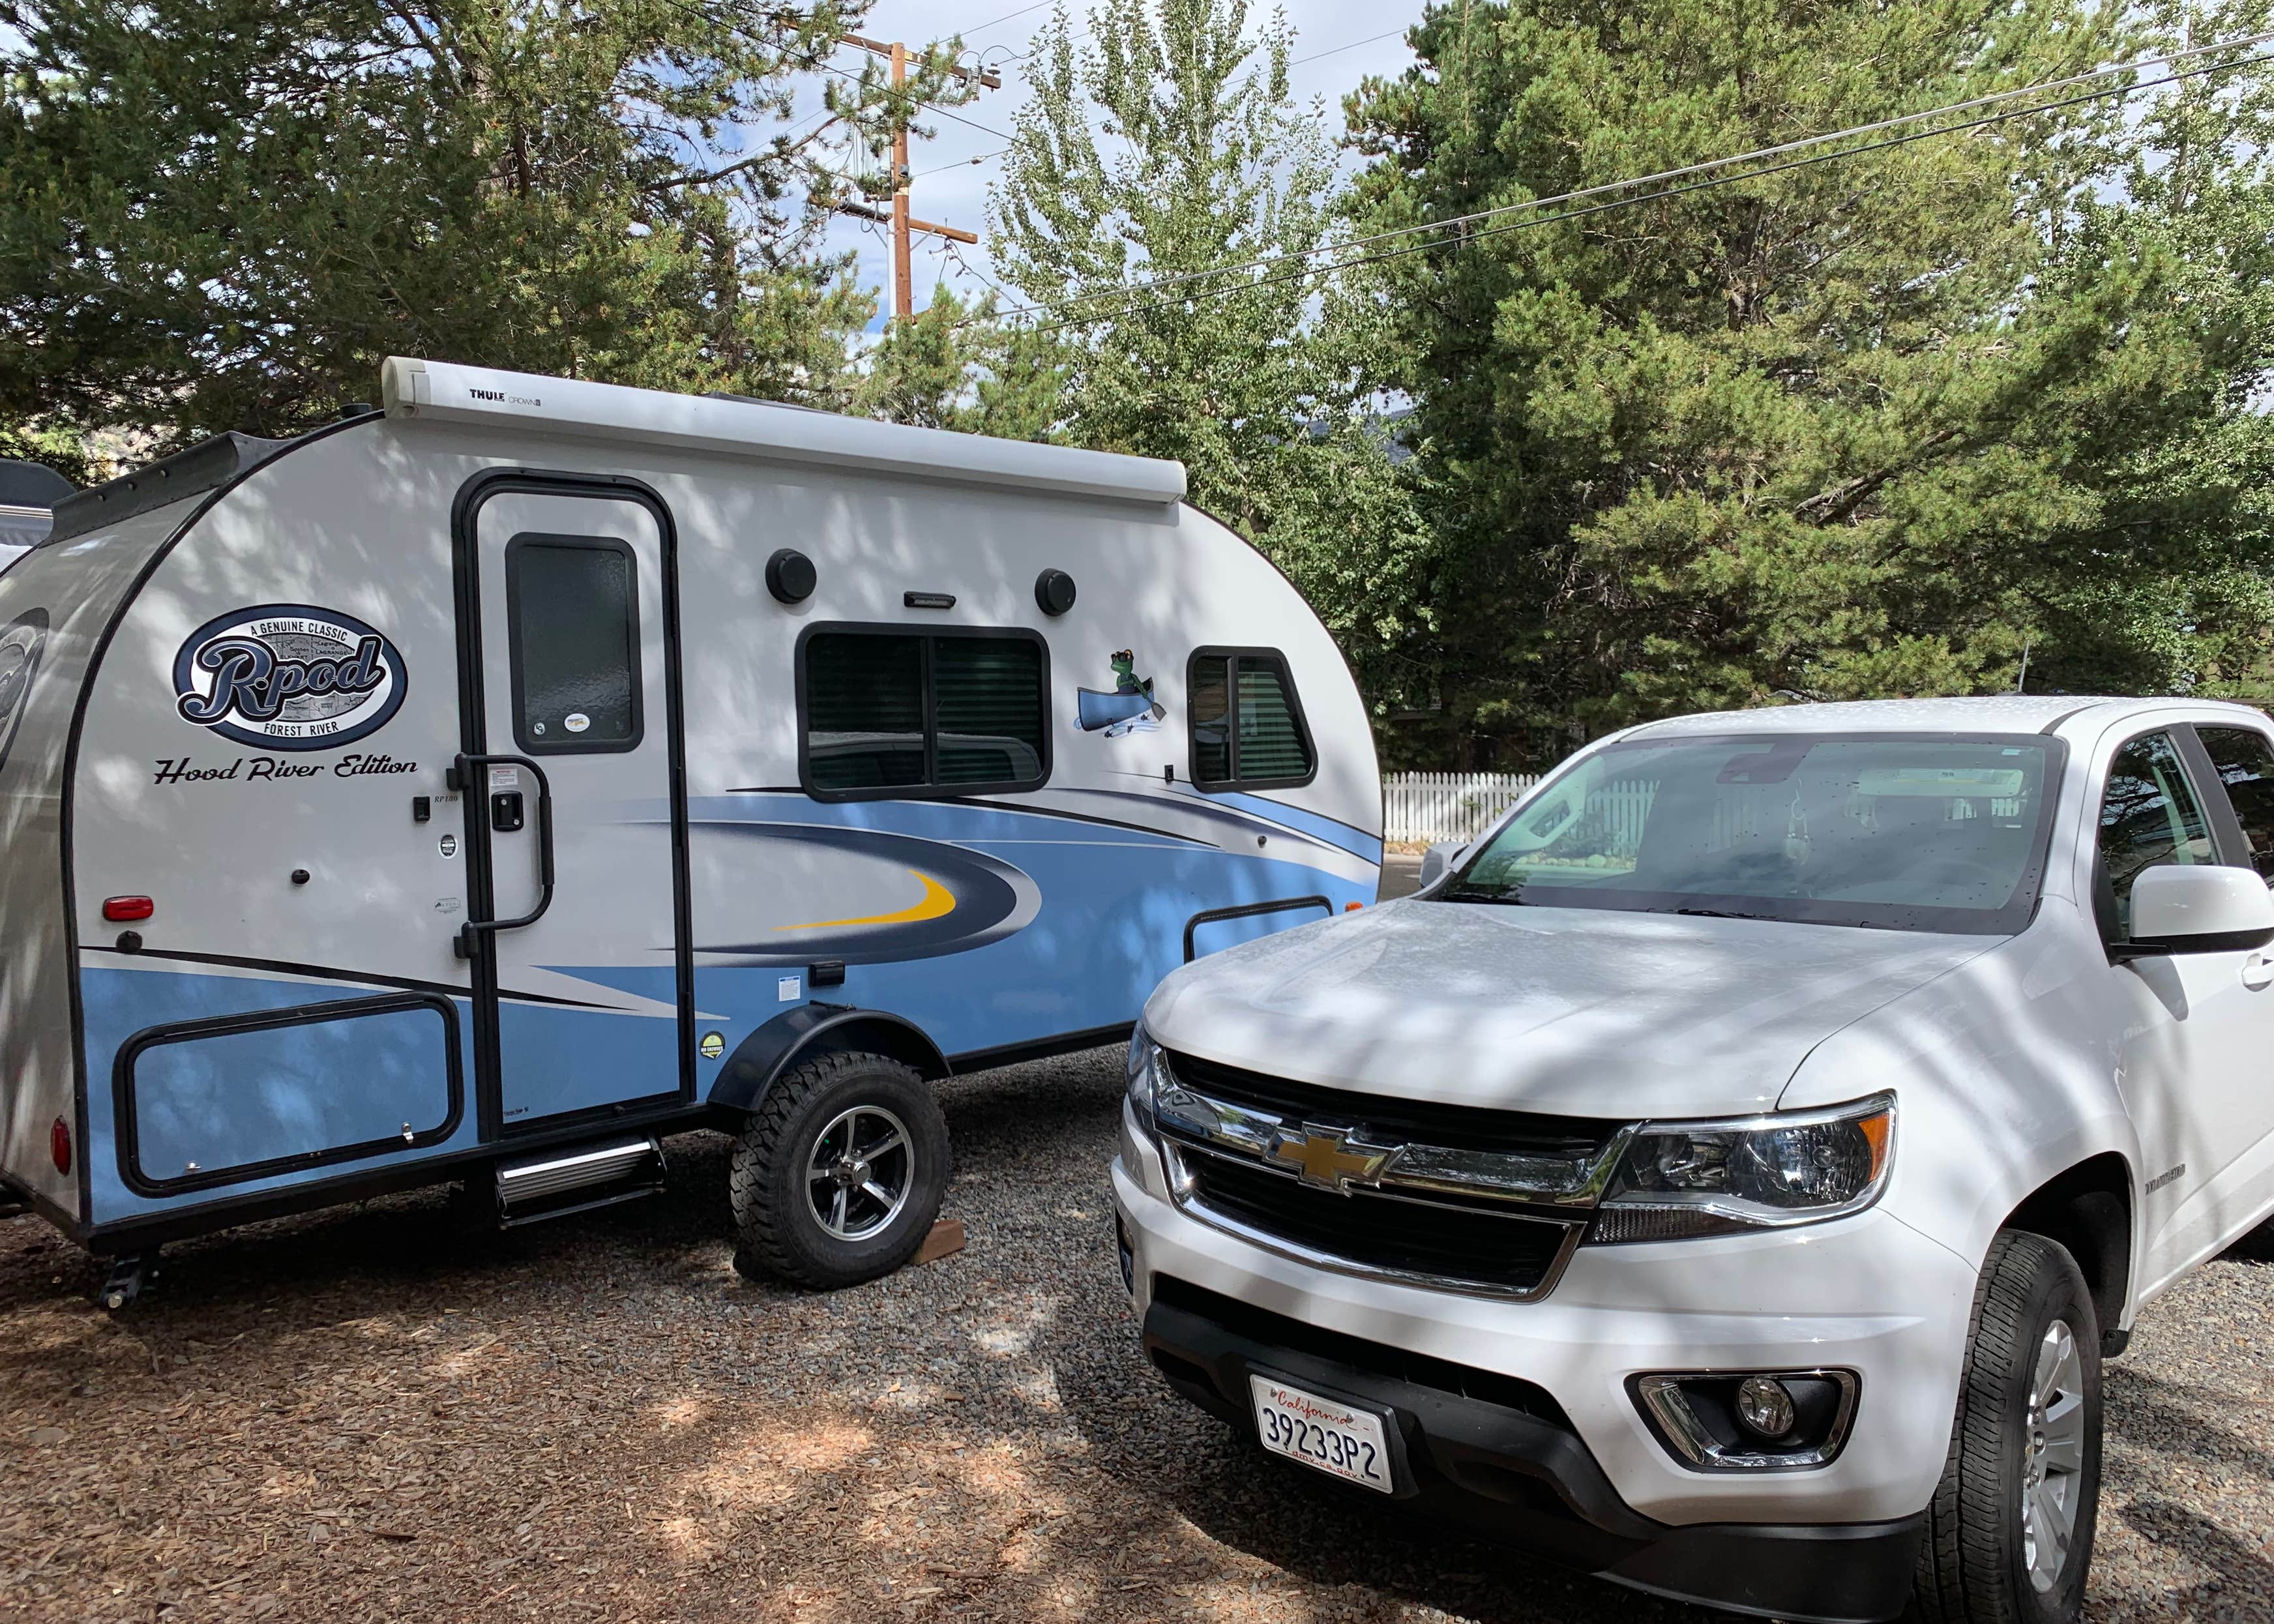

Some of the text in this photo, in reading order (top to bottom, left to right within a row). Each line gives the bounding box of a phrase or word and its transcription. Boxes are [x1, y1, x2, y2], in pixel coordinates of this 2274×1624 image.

[469, 389, 505, 402] THULE
[251, 621, 348, 642] A GENUINE CLASSIC
[264, 722, 339, 736] FOREST RIVER
[154, 754, 419, 785] Hood River Edition
[1278, 1391, 1357, 1431] California
[1263, 1408, 1381, 1479] 39233P2
[1292, 1451, 1358, 1479] dmv.ca.gov
